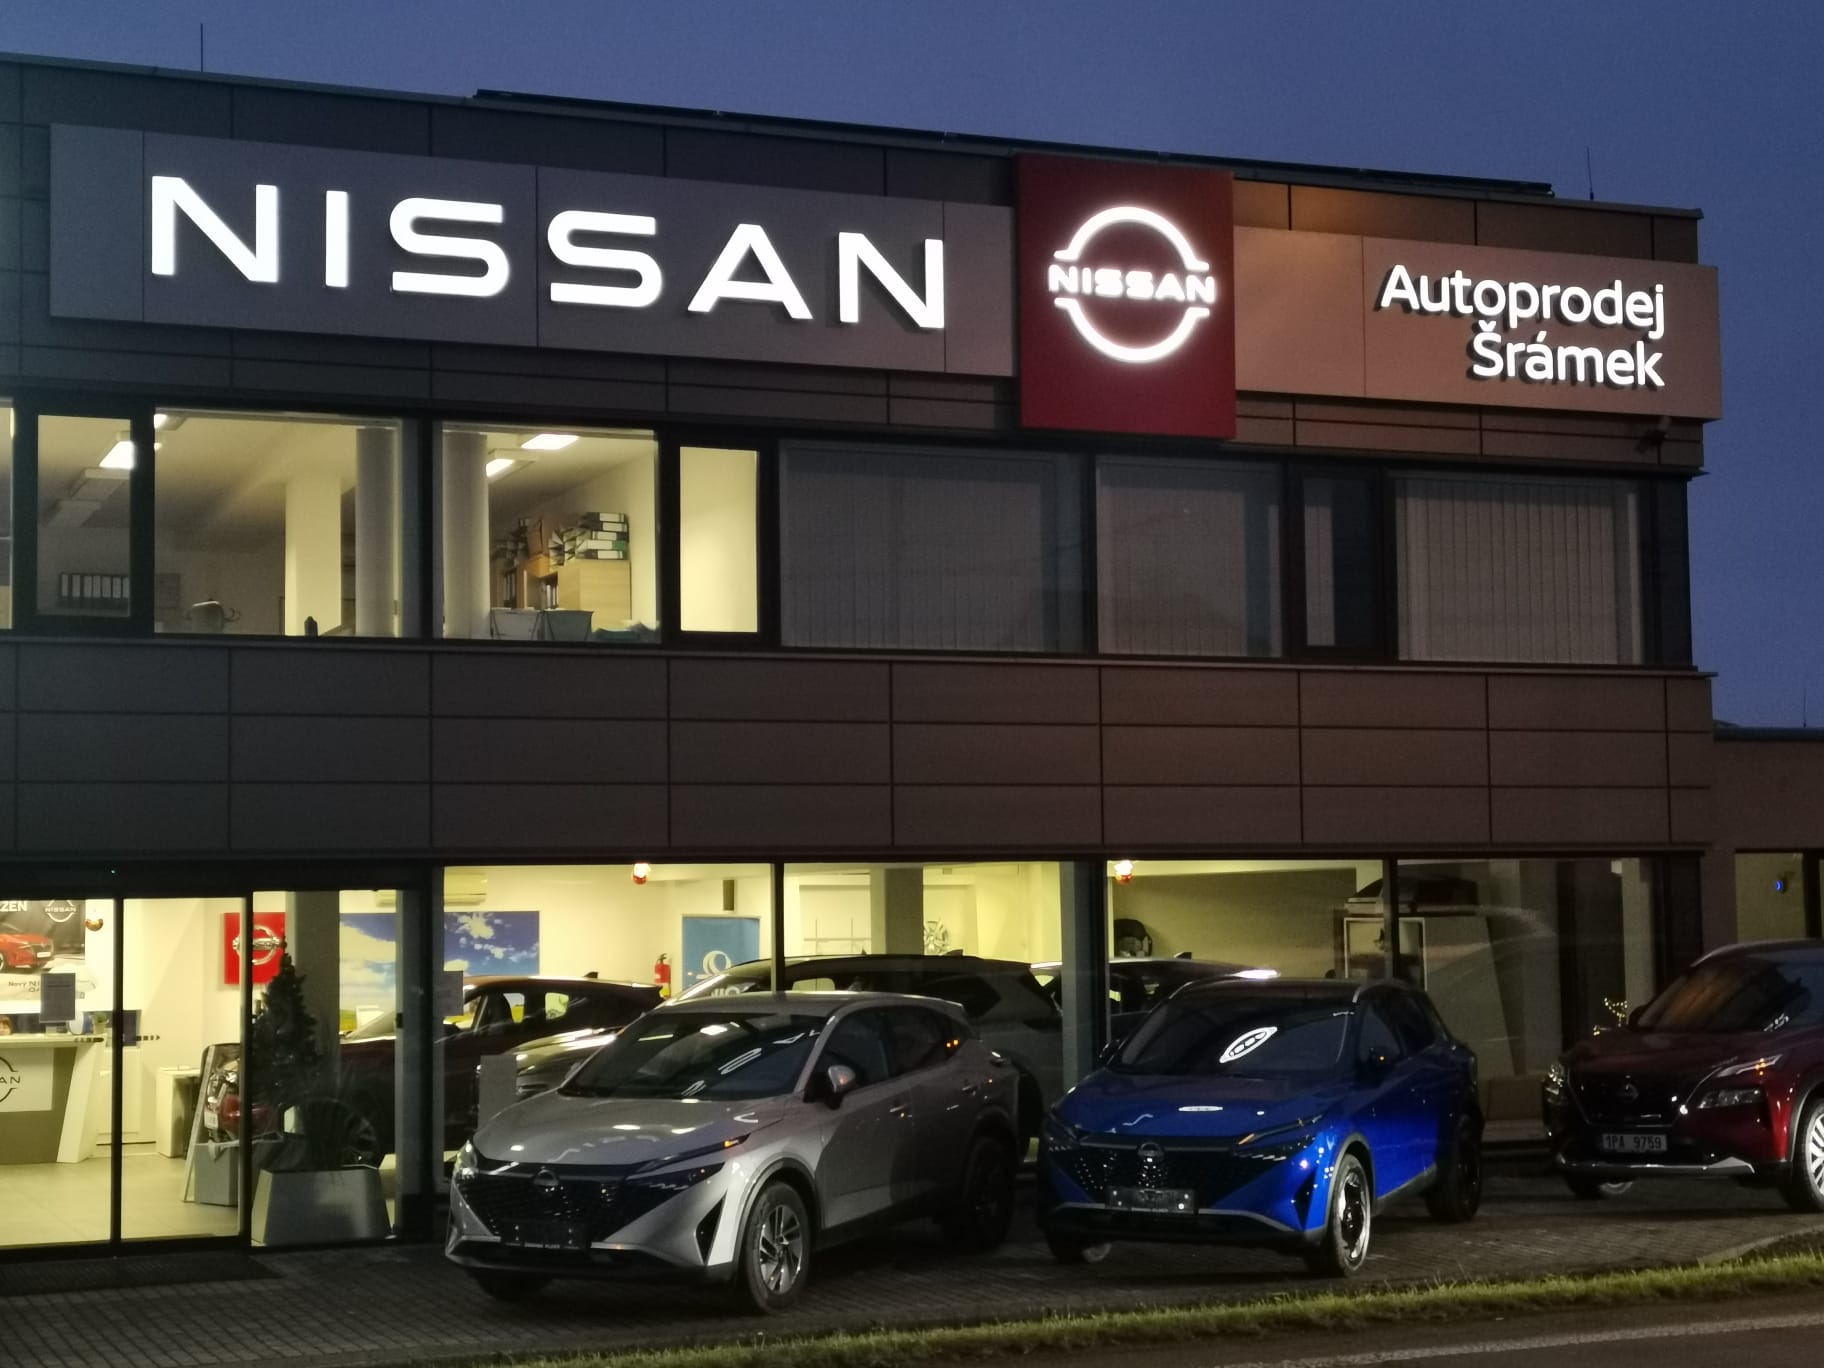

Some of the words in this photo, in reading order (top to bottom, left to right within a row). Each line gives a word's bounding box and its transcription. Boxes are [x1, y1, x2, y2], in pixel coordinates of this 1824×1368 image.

[151, 175, 945, 329] NISSAN
[1048, 264, 1216, 304] NISSAN
[1380, 264, 1666, 340] Autoprodej
[1473, 319, 1666, 387] Šrámek
